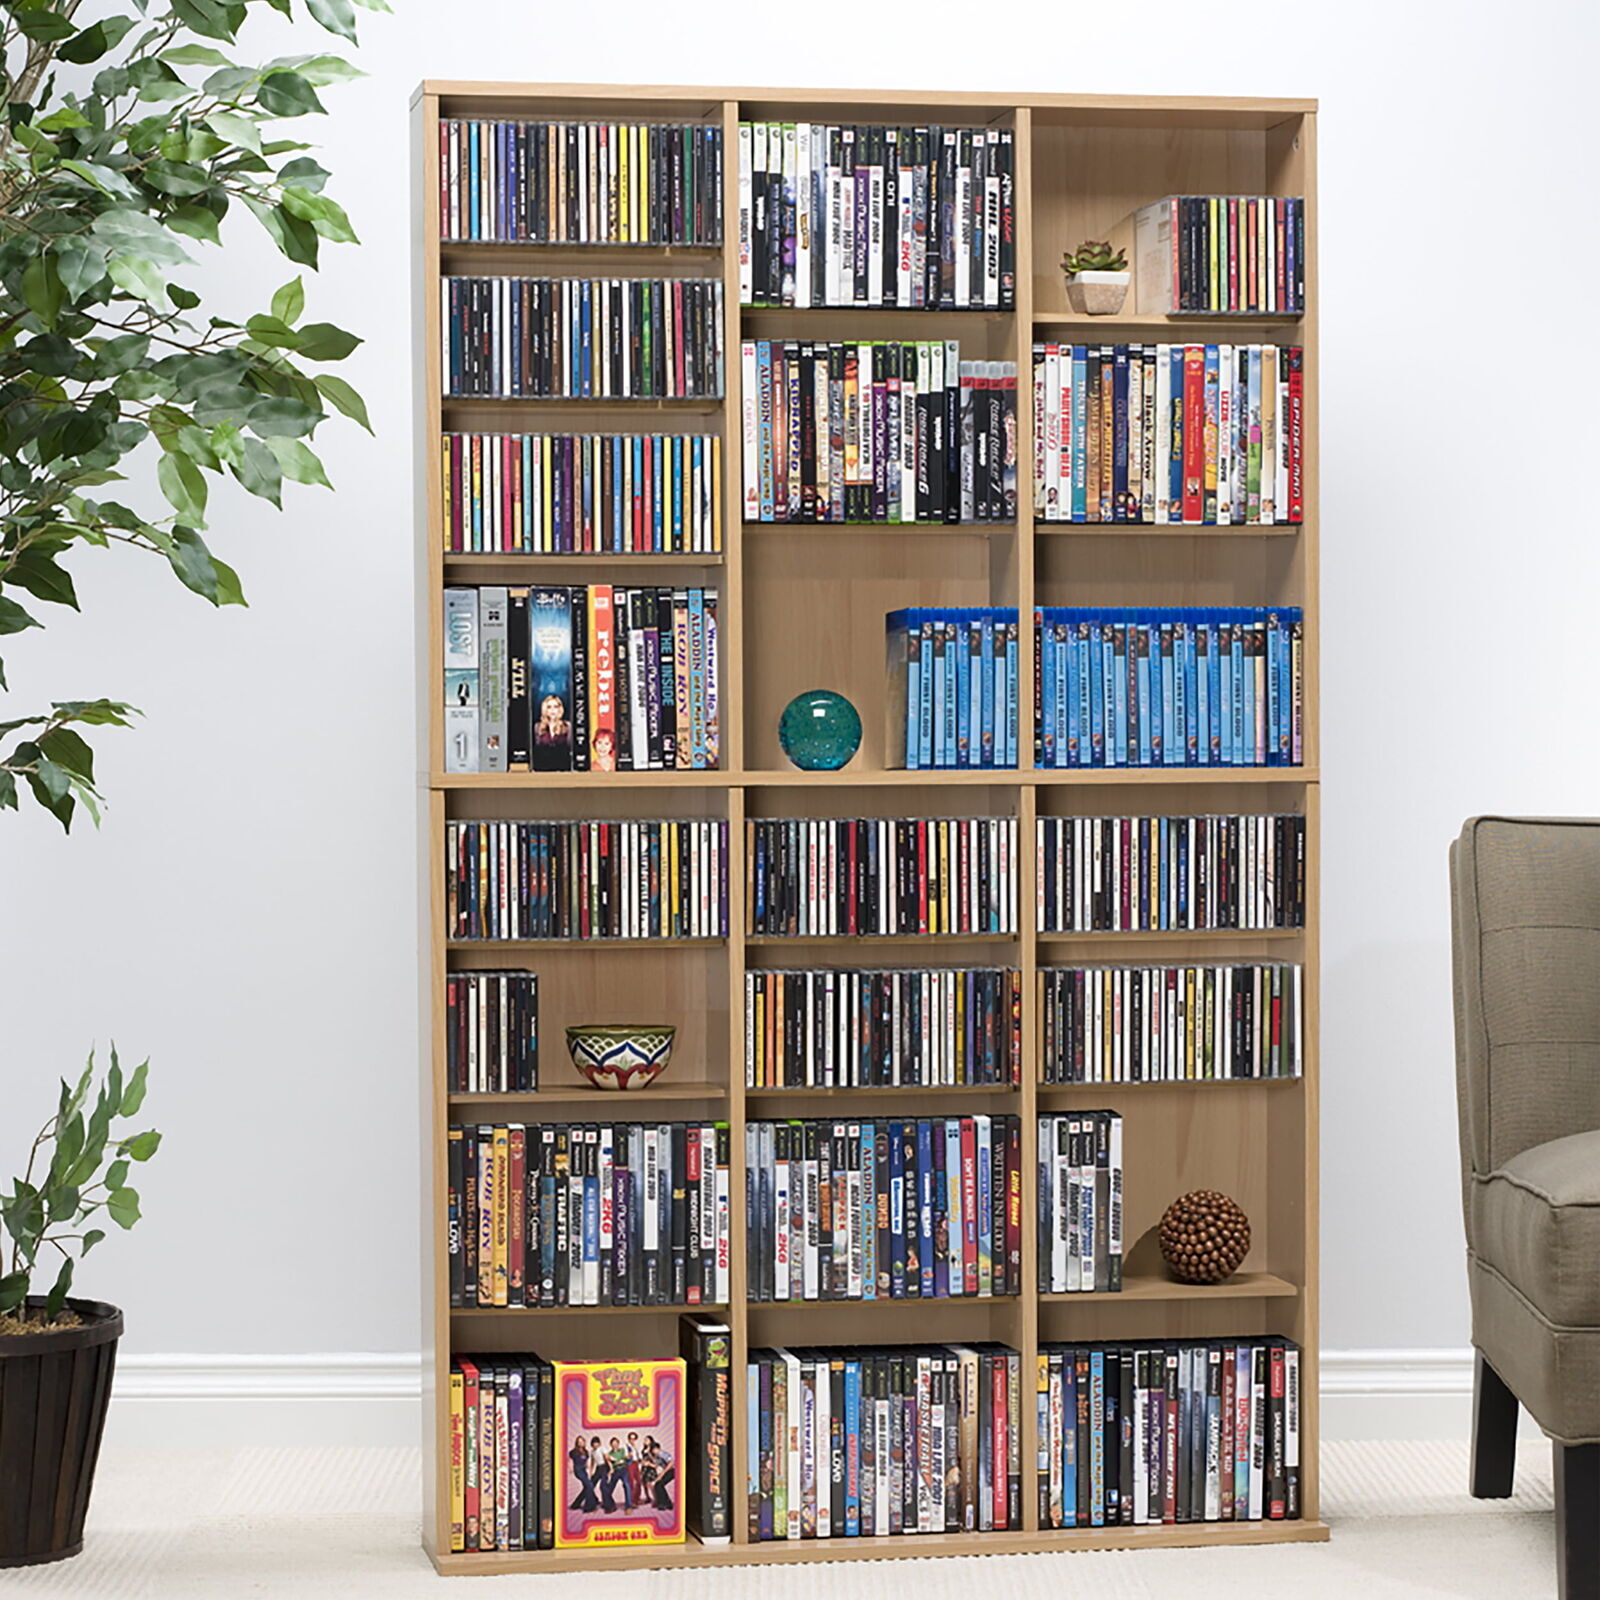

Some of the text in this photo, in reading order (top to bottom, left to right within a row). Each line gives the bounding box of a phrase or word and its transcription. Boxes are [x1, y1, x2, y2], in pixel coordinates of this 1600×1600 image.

[988, 233, 997, 279] 2003
[761, 364, 770, 423] ALADDIN
[790, 379, 800, 471] KIDNAPPED
[1145, 395, 1153, 480] Black Arrow
[918, 482, 929, 495] 6
[449, 612, 472, 656] LOST
[692, 612, 701, 670] ALADDIN
[707, 628, 716, 688] Westward
[512, 658, 525, 698] TILT
[597, 630, 613, 716] reba
[661, 630, 673, 706] THE INSIDE
[678, 674, 686, 717] ROY
[454, 732, 468, 762] 1
[863, 1147, 872, 1204] ALADDIN
[994, 1142, 1004, 1252] WRITTEN IN BLOOD
[1010, 1170, 1019, 1193] Little
[482, 1209, 491, 1251] ROY
[557, 1185, 567, 1252] TRAFFIC
[690, 1190, 698, 1233] MIDNIGHT
[906, 1171, 916, 1239] swimfan
[719, 1238, 727, 1269] 2K6
[778, 1233, 787, 1264] 2K6
[716, 1373, 728, 1445] MUPPETS
[1093, 1375, 1102, 1432] ALADDIN
[920, 1390, 930, 1476] BASKETBALL
[483, 1455, 493, 1495] ROY
[707, 1442, 721, 1495] SPACE
[933, 1426, 942, 1506] NBA LIVE 2001
[1166, 1474, 1175, 1499] 2003
